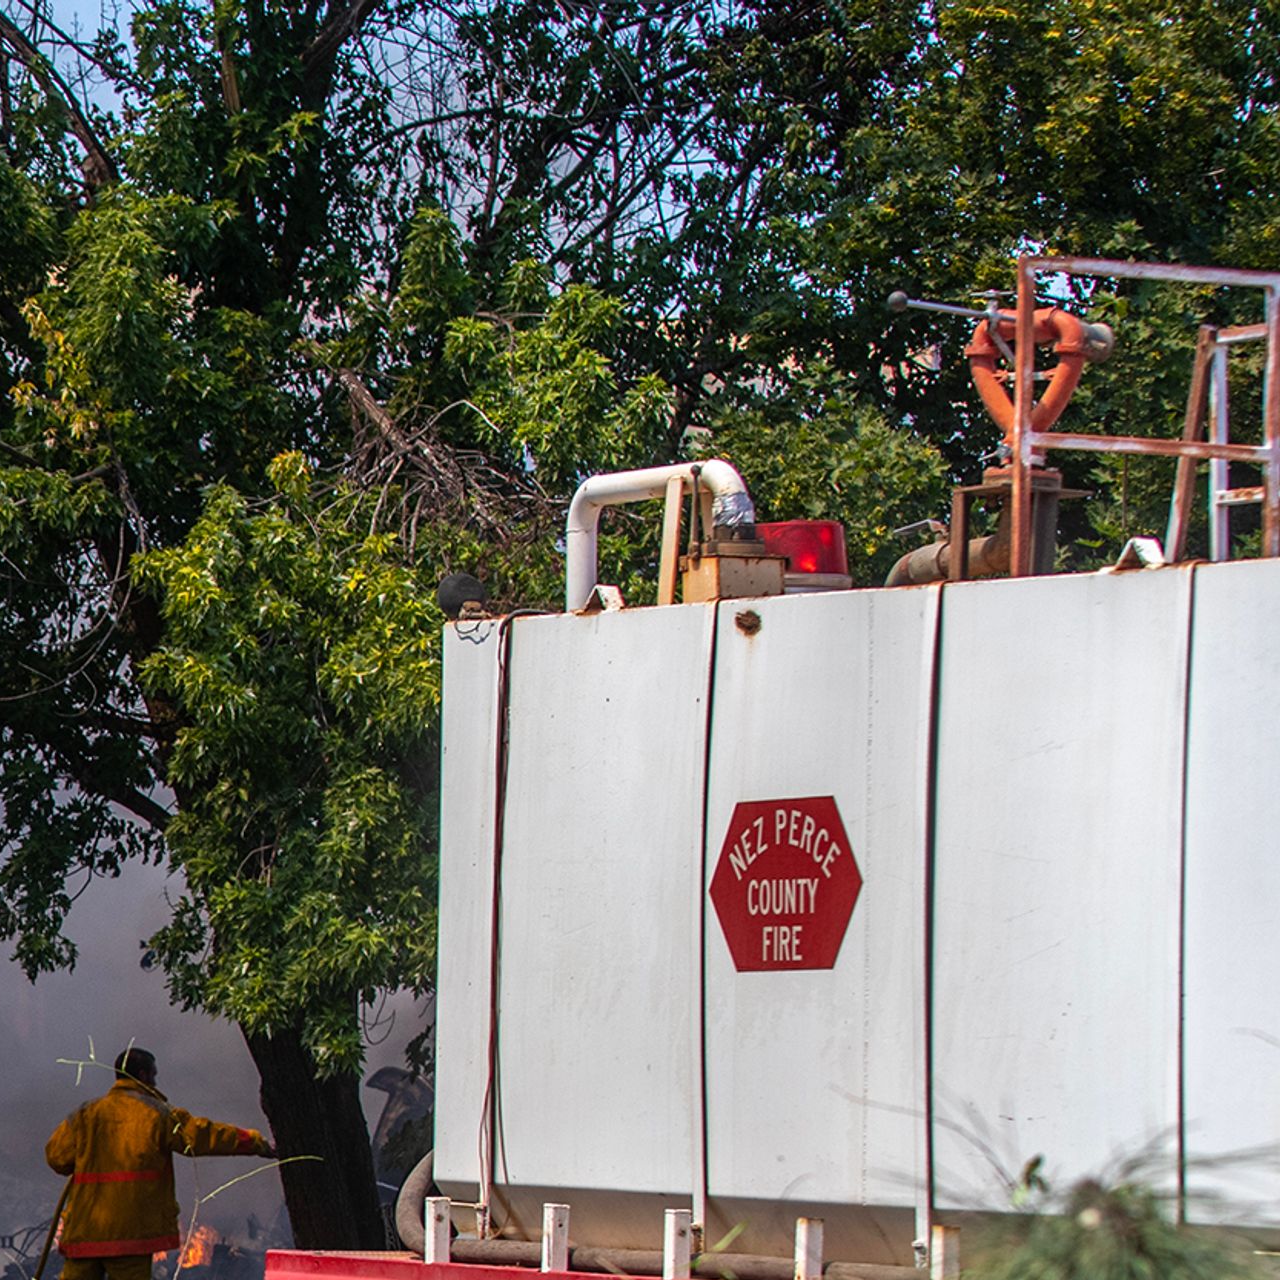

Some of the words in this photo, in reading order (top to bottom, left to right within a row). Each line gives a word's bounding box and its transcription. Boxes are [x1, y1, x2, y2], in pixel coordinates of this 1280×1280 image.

[728, 816, 768, 881] NEZ
[775, 809, 842, 878] PERCE
[747, 878, 819, 916] COUNTY
[762, 926, 803, 961] FIRE
